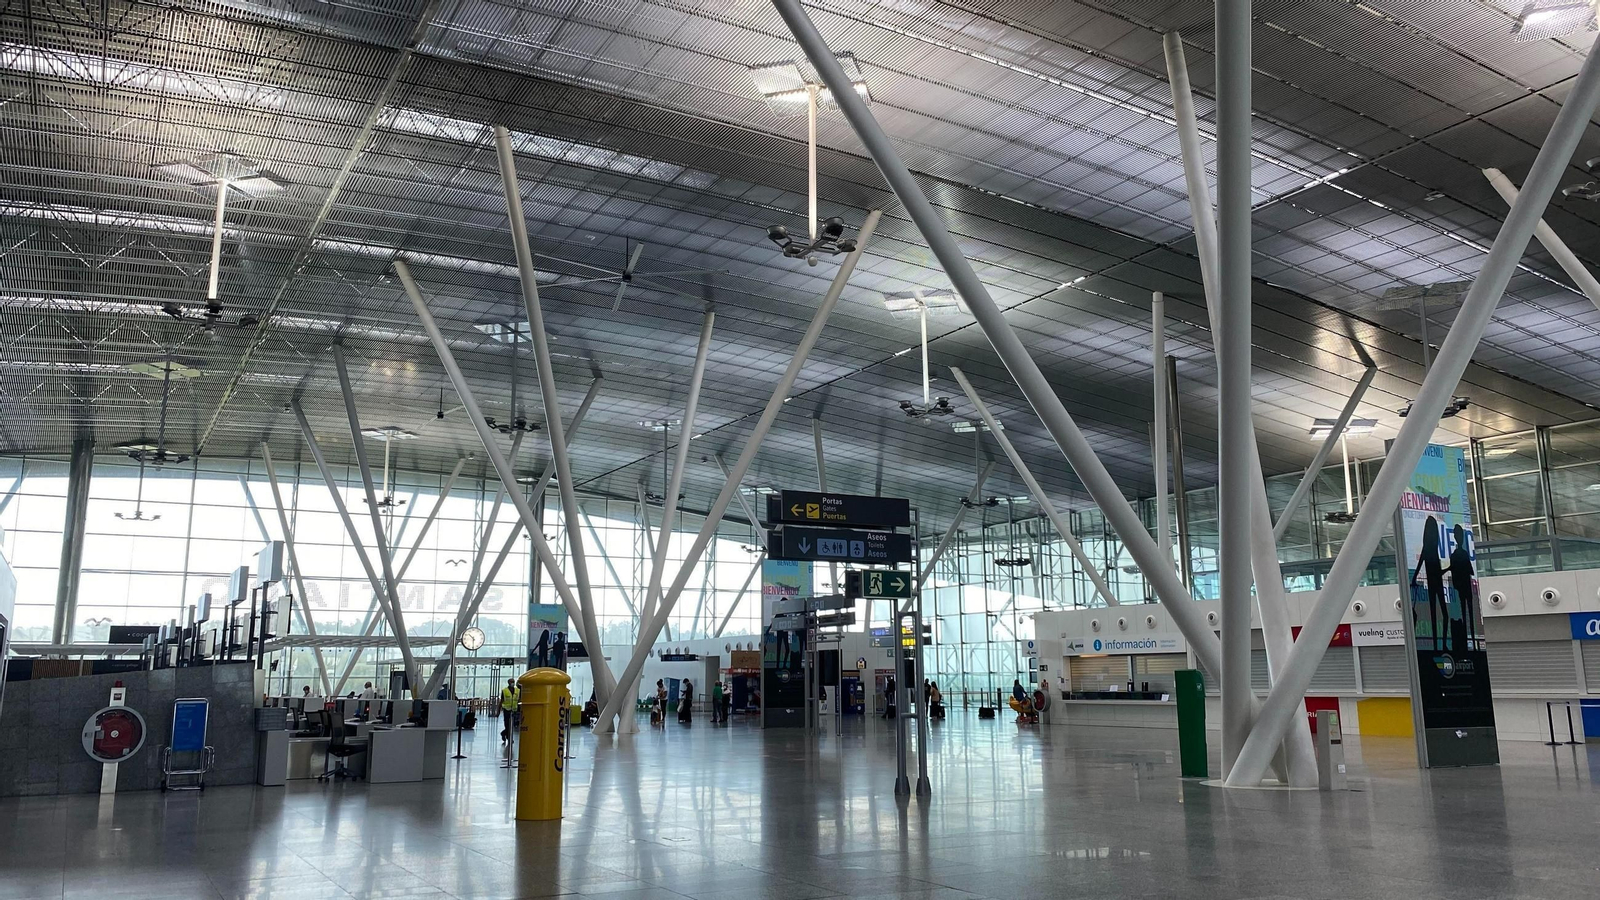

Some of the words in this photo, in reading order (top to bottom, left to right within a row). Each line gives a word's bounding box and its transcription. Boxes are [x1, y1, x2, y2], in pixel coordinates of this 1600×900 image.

[822, 497, 843, 505] Portas
[822, 512, 847, 521] Puertas
[867, 533, 887, 541] Aseos
[867, 541, 885, 549] Toilets
[867, 550, 888, 558] Aseos
[1358, 628, 1384, 639] vueling
[1104, 638, 1157, 649] información
[554, 696, 566, 772] Correos
